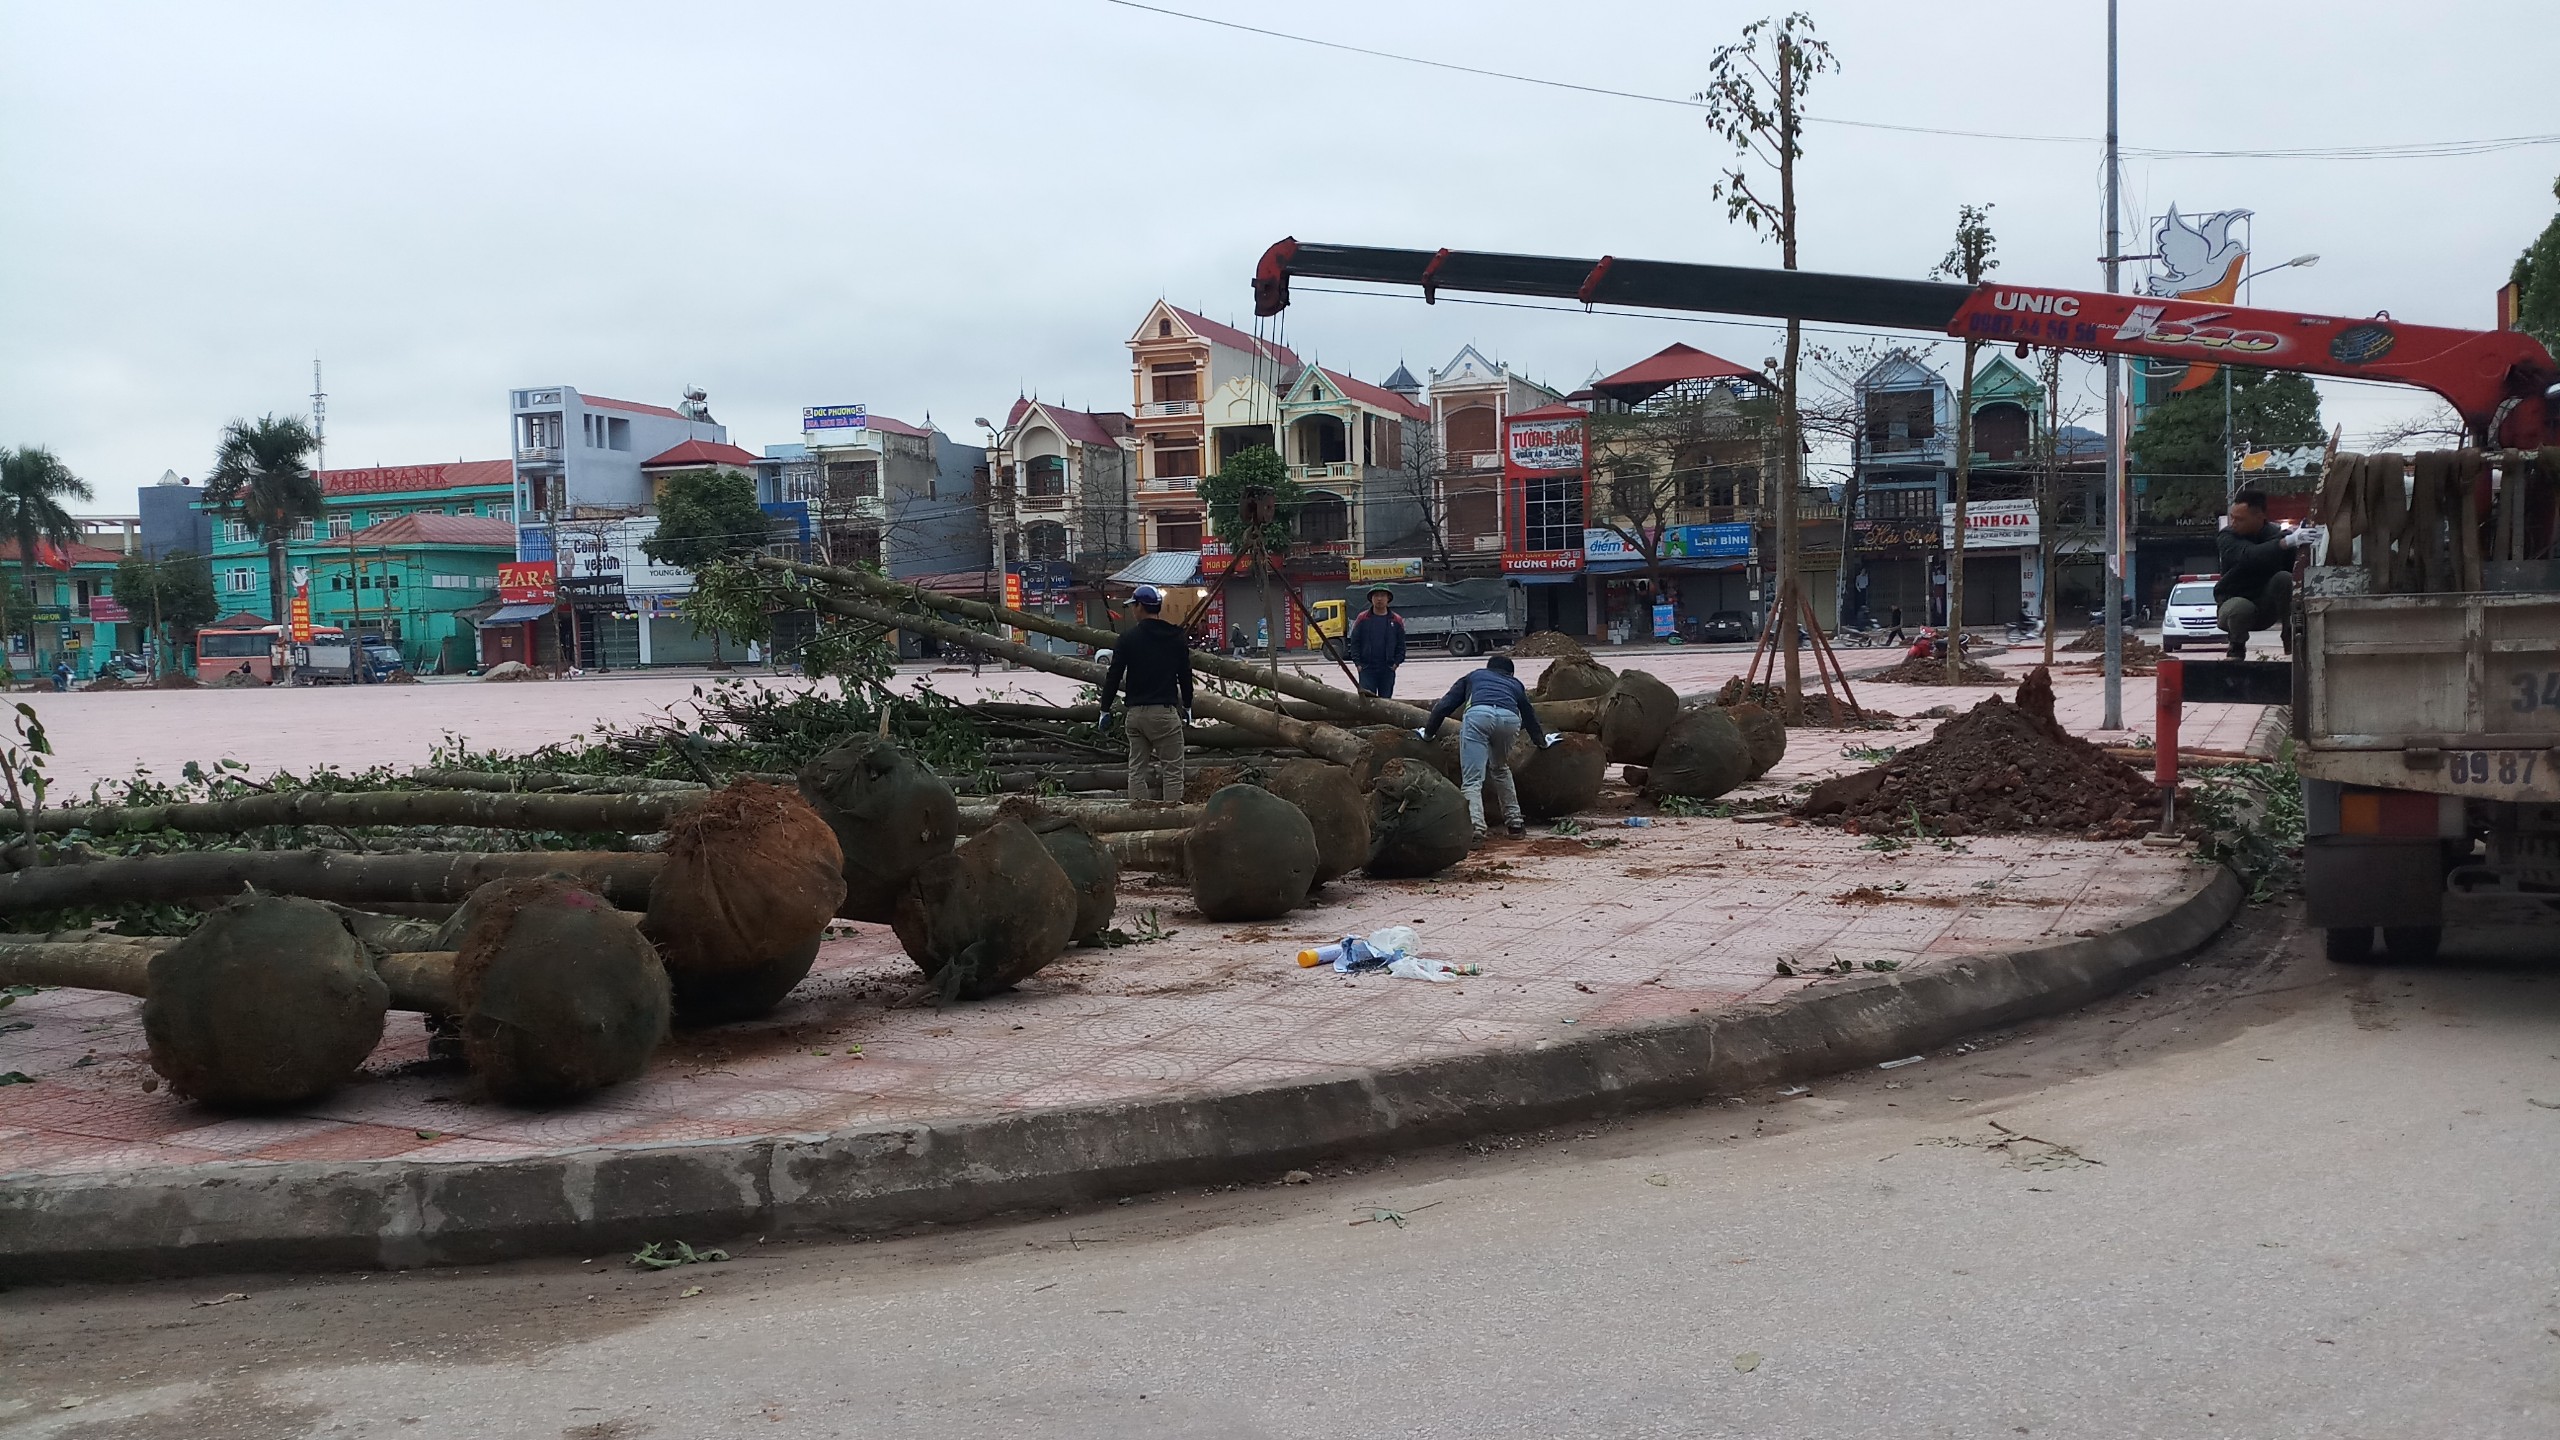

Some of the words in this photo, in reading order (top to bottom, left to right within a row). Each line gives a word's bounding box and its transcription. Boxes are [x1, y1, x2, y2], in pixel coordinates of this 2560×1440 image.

[1993, 291, 2080, 317] UNIC
[813, 408, 827, 417] ĐỨC
[1512, 428, 1553, 449] TƯỜNG
[327, 465, 450, 492] AGRIBANK
[1720, 534, 1749, 545] BÌNH
[649, 569, 674, 577] YOUNG
[1507, 557, 1548, 569] TƯỜNG
[498, 568, 554, 589] ZARA
[1283, 595, 1292, 640] SAMSUNG
[2498, 750, 2538, 785] 87
